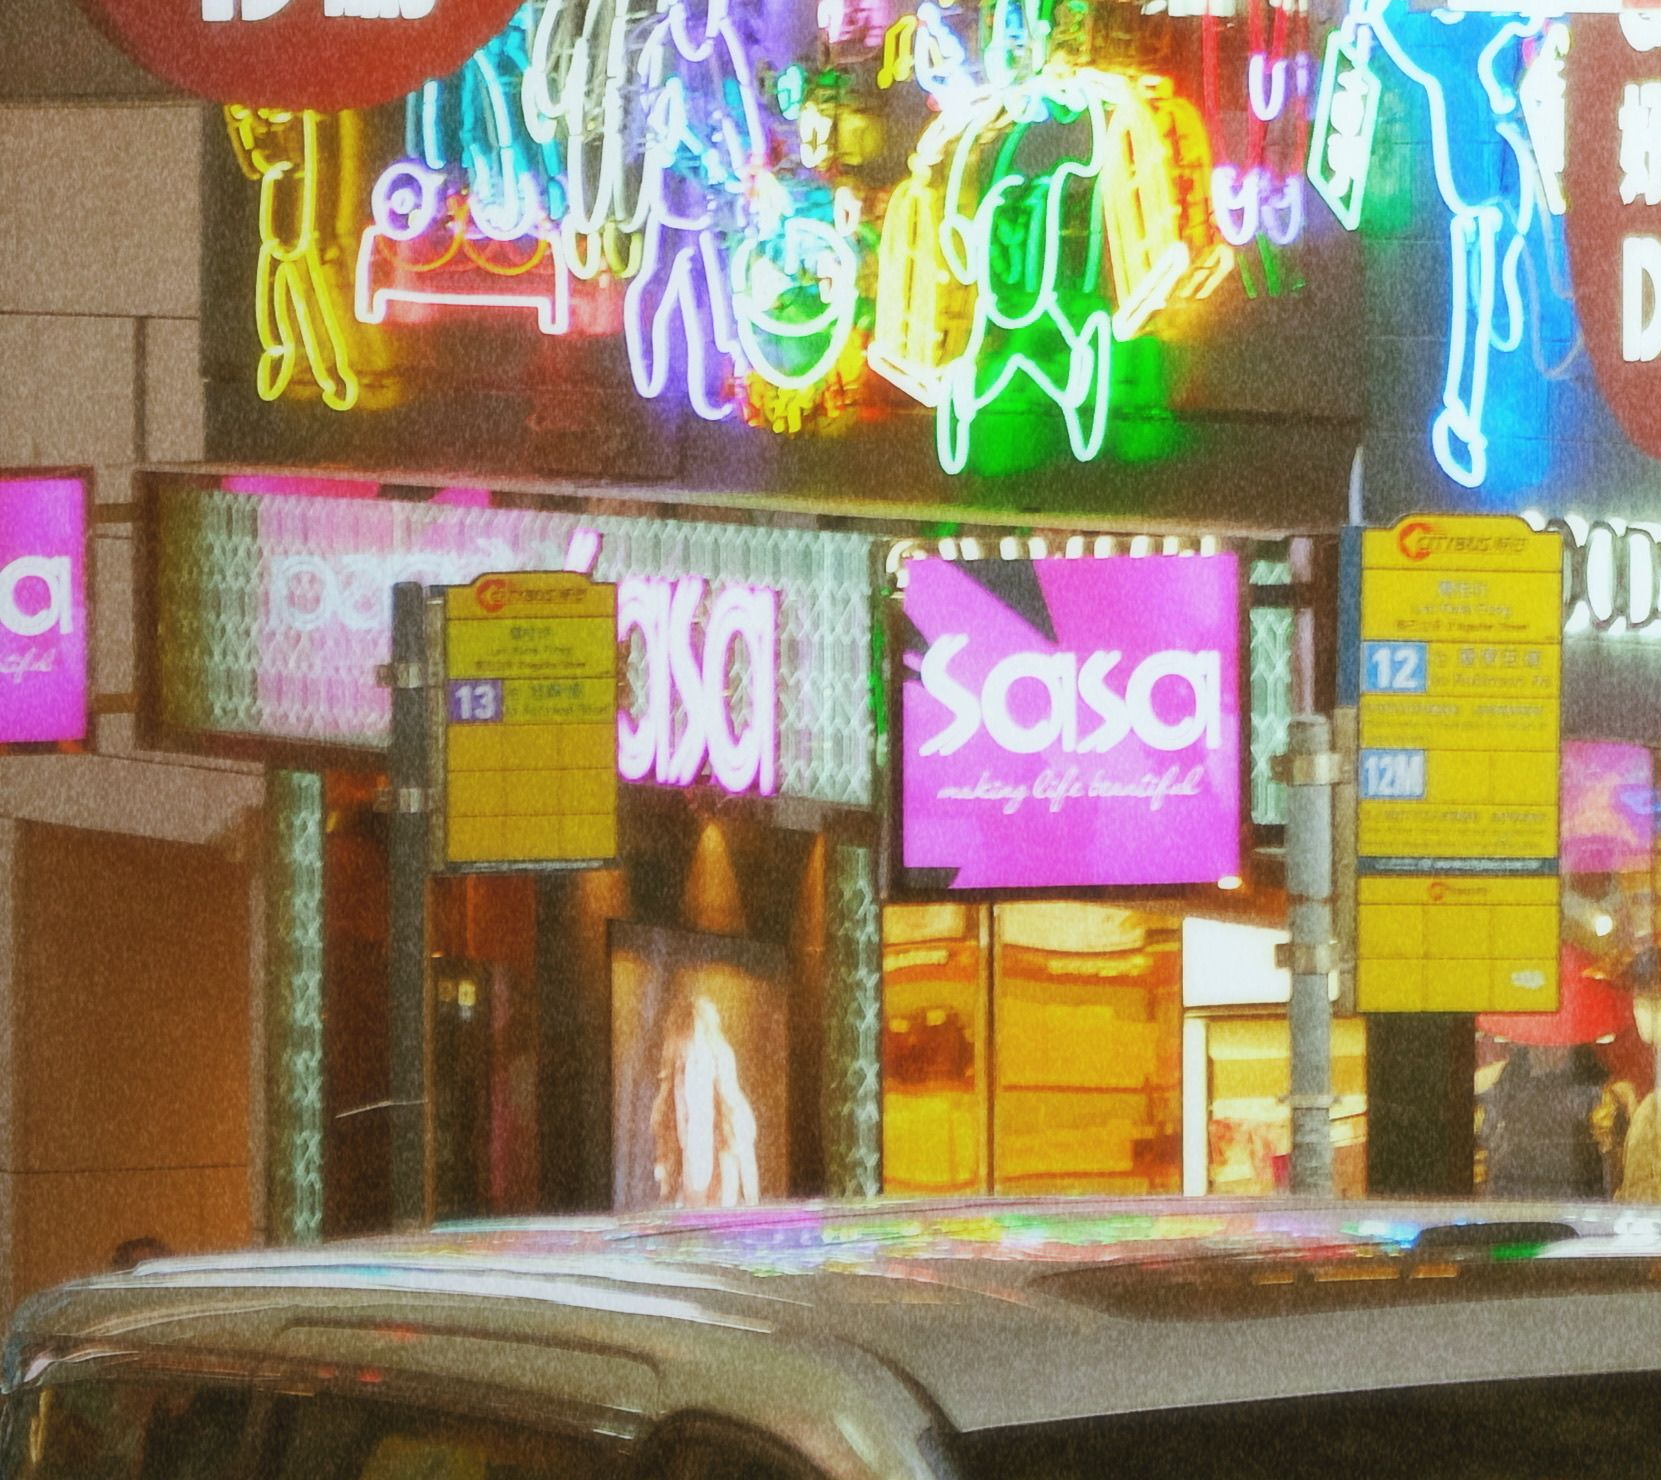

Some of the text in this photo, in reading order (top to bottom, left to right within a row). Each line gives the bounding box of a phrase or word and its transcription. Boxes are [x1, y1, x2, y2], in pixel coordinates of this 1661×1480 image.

[1371, 646, 1419, 689] 12
[455, 683, 497, 720] 13
[1032, 768, 1084, 813] life
[1363, 754, 1425, 796] 12M
